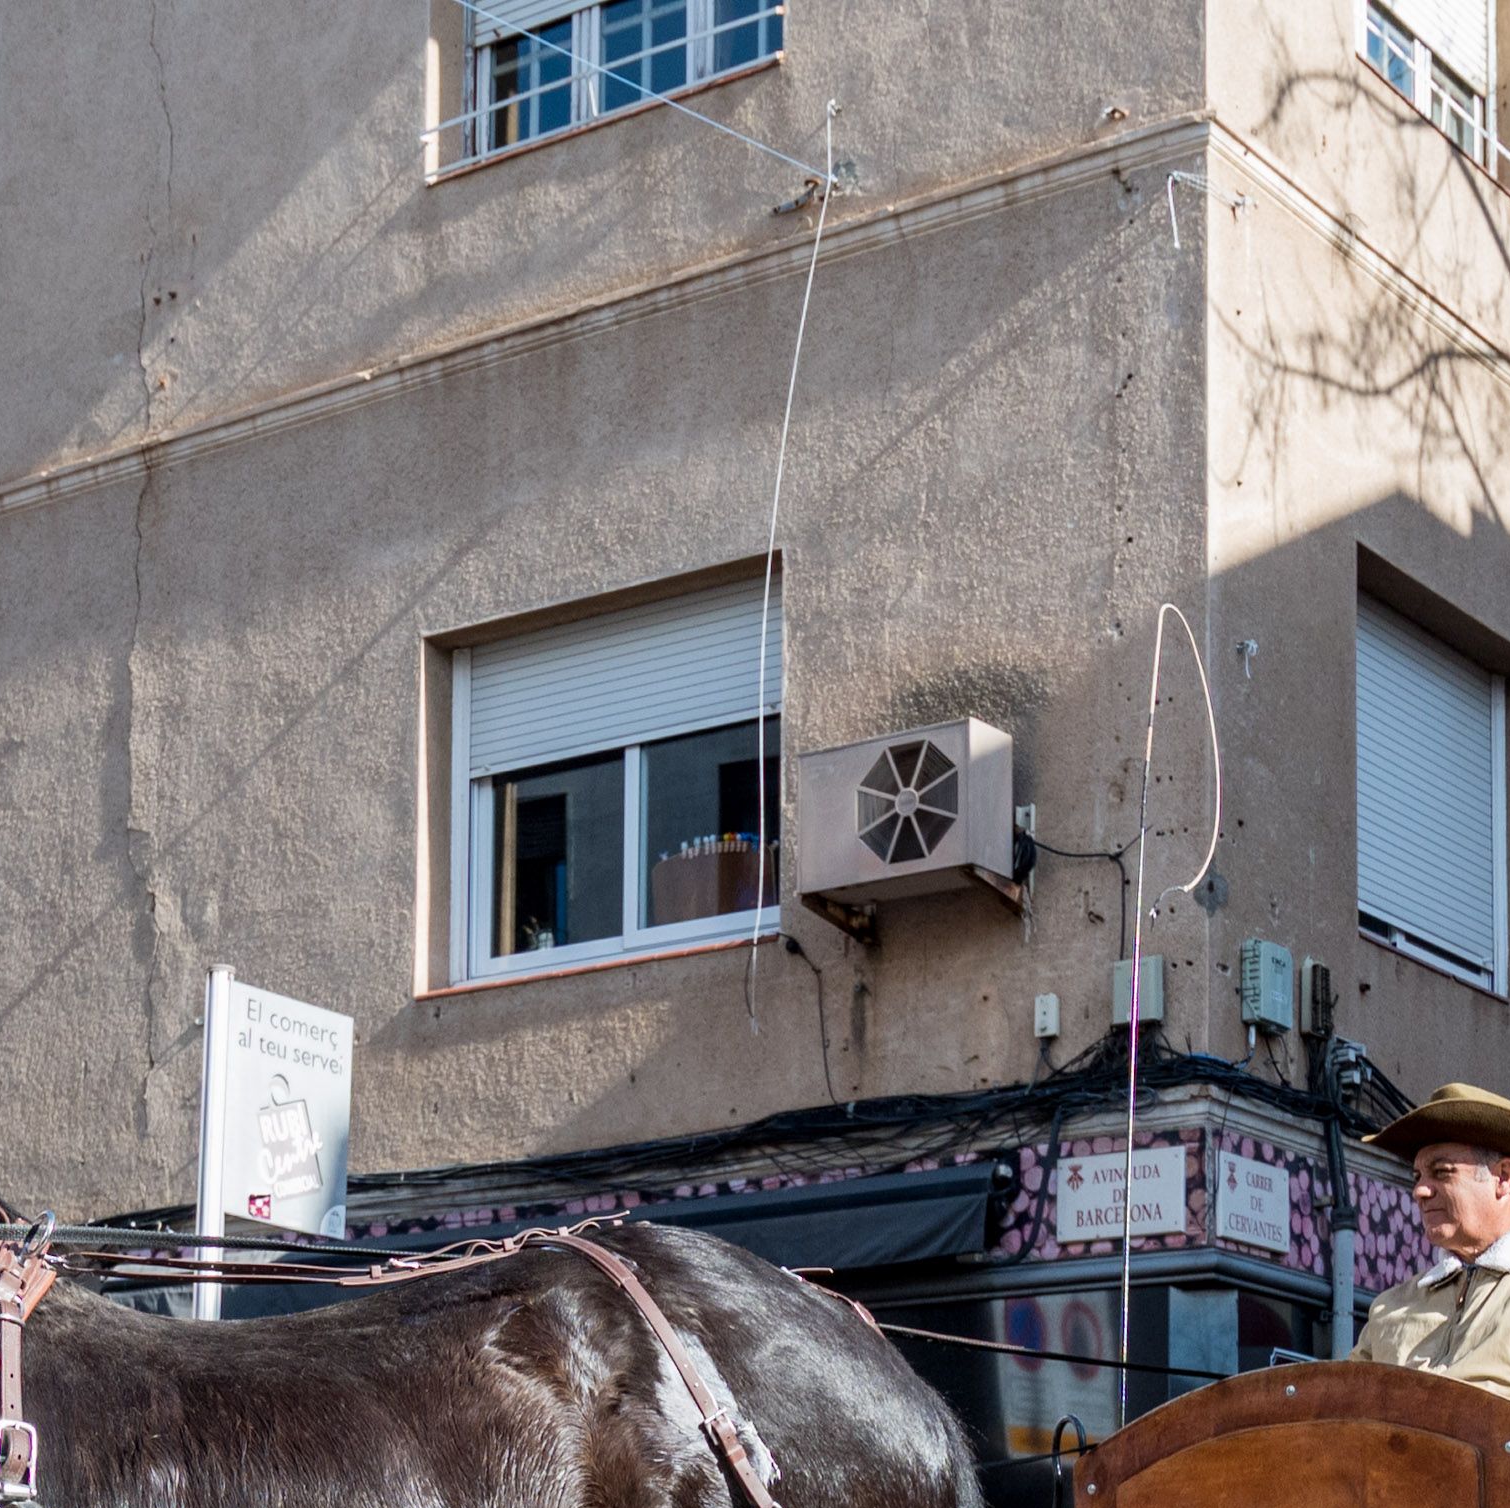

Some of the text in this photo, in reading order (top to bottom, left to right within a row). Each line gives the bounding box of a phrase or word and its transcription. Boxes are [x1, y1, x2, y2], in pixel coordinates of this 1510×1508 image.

[247, 997, 339, 1049] El comerç
[238, 1029, 343, 1076] al teu servei
[1245, 1171, 1274, 1193] CARRER
[1076, 1203, 1163, 1228] BARCEONA
[1250, 1195, 1264, 1213] DE
[1229, 1213, 1282, 1243] CERVANTES
